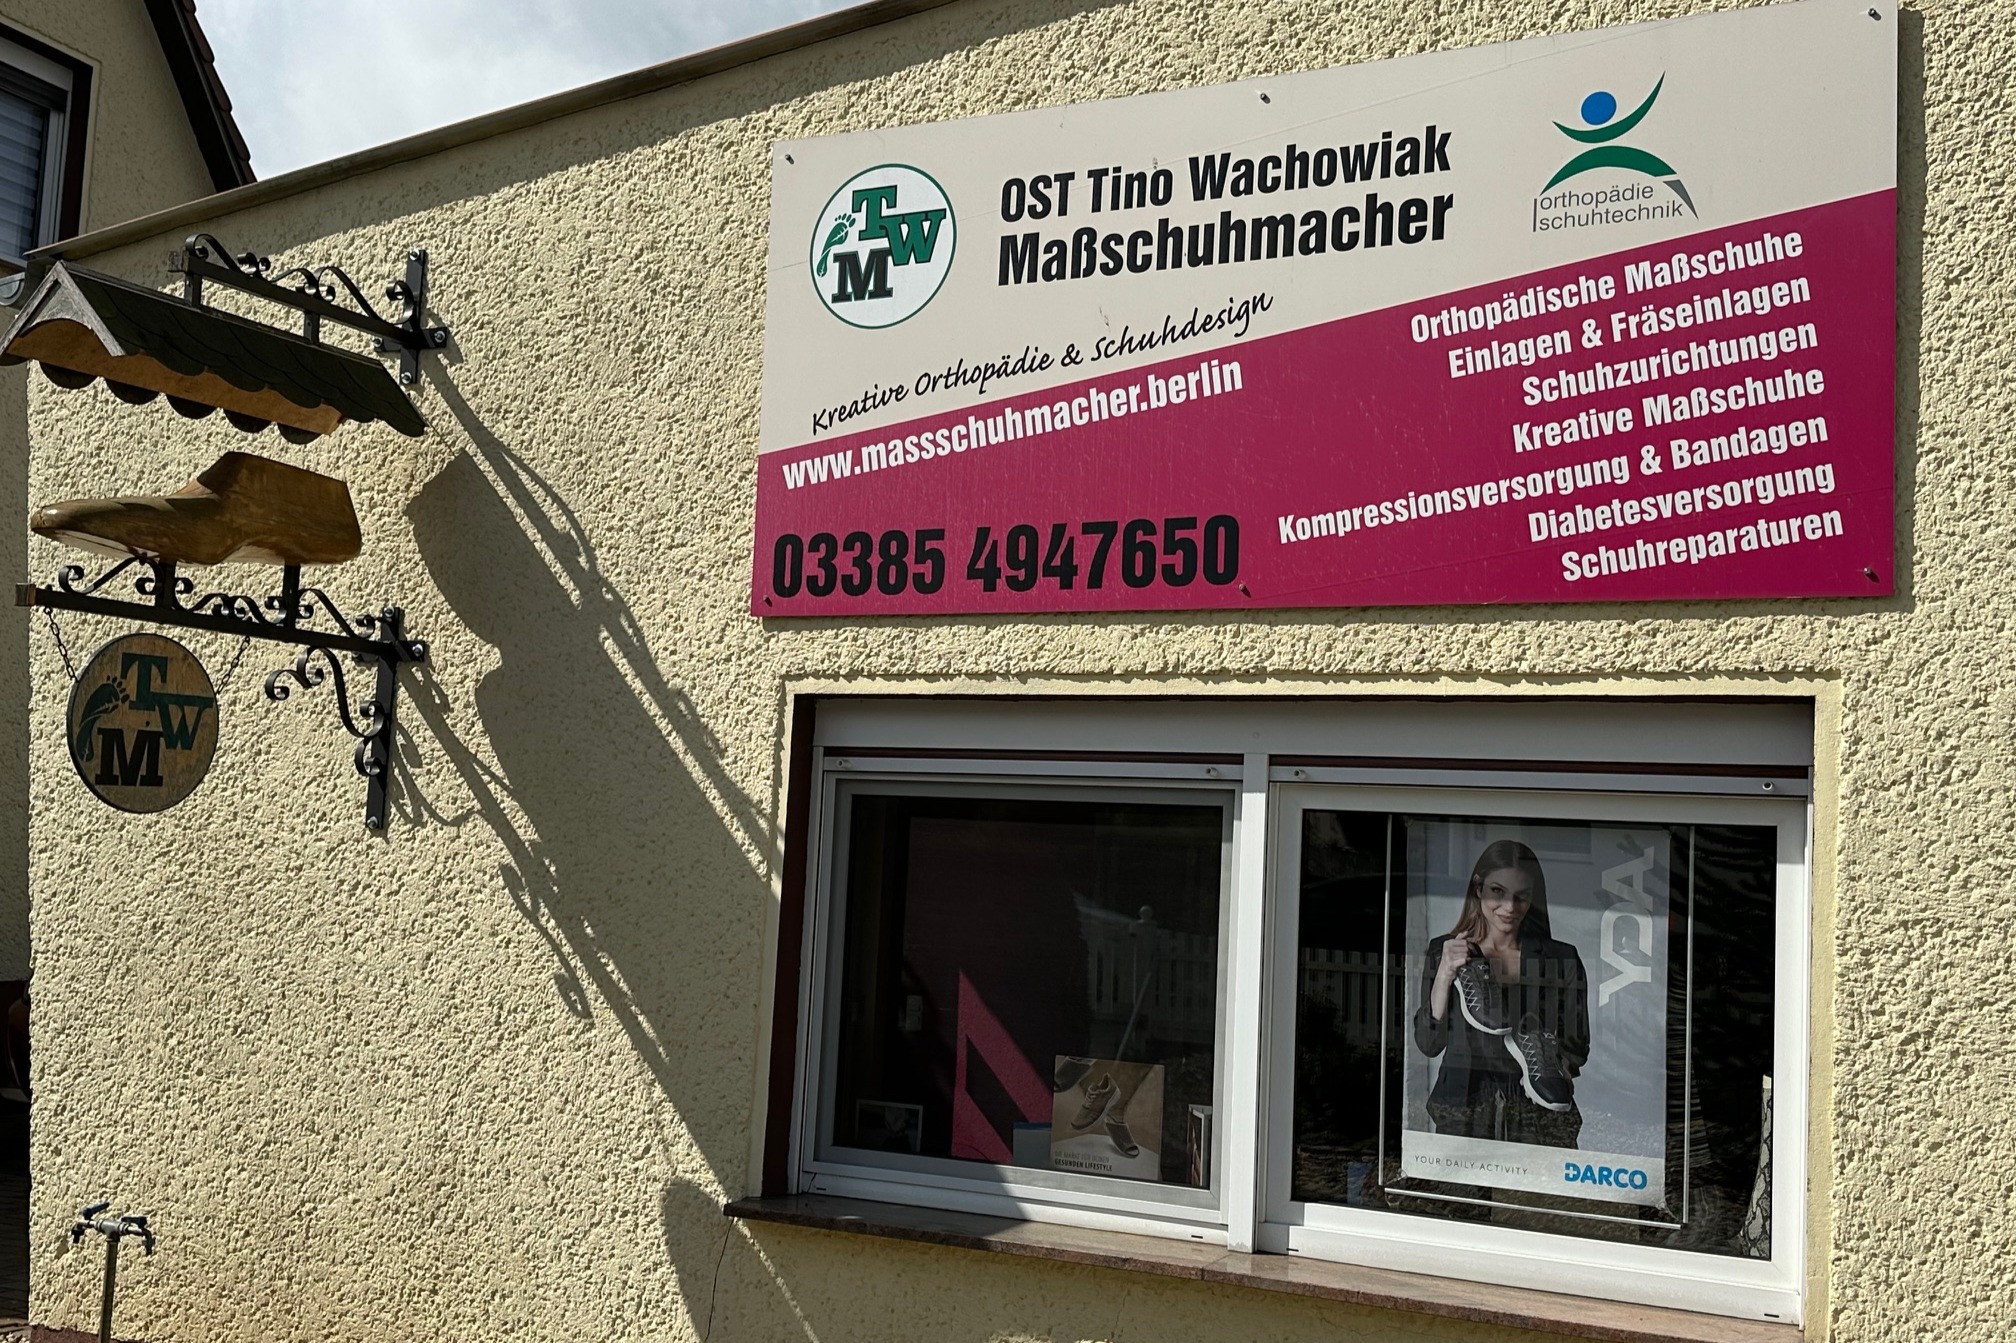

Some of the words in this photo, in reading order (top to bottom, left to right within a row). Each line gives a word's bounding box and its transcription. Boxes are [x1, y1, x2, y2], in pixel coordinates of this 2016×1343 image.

[1001, 172, 1075, 223] OST
[1087, 166, 1174, 213] Tino
[1188, 125, 1452, 202] Wachowiak
[1539, 182, 1654, 210] orthopädie
[1539, 200, 1683, 231] schuhtechnik
[998, 192, 1454, 286] Maßschuhmacher
[1410, 274, 1616, 344] Orthopädische
[1624, 231, 1804, 294] Maßschuhe
[1448, 327, 1572, 379] Einlagen
[1580, 319, 1604, 348] &
[1610, 276, 1811, 344] Fräseinlagen
[811, 384, 909, 435] Kreative
[914, 346, 1055, 394] Orthopädie
[1060, 343, 1084, 367] &
[1091, 292, 1274, 362] Schuhdesign
[1522, 320, 1818, 407] Schuhzurichtungen
[782, 359, 1243, 490] www.massschuhmacher.berlin
[1512, 404, 1634, 454] Kreative
[1642, 364, 1825, 428] Maßschuhe
[1278, 453, 1630, 545] Kompressionsversorgung
[1640, 445, 1663, 475] &
[1670, 414, 1828, 471] Bandagen
[1529, 462, 1836, 543] Diabetesversorgung
[773, 528, 945, 598] 03385
[966, 514, 1241, 593] 4947650
[1561, 508, 1843, 583] Schuhreparaturen
[1599, 846, 1655, 1008] YDA
[1054, 1158, 1084, 1168] GESUNDEN
[1085, 1161, 1113, 1171] LIFESTYLE
[1414, 1154, 1442, 1166] YOUR
[1445, 1158, 1475, 1170] DAILY
[1479, 1162, 1529, 1175] ACTIVITY
[1564, 1162, 1648, 1190] DARCO
